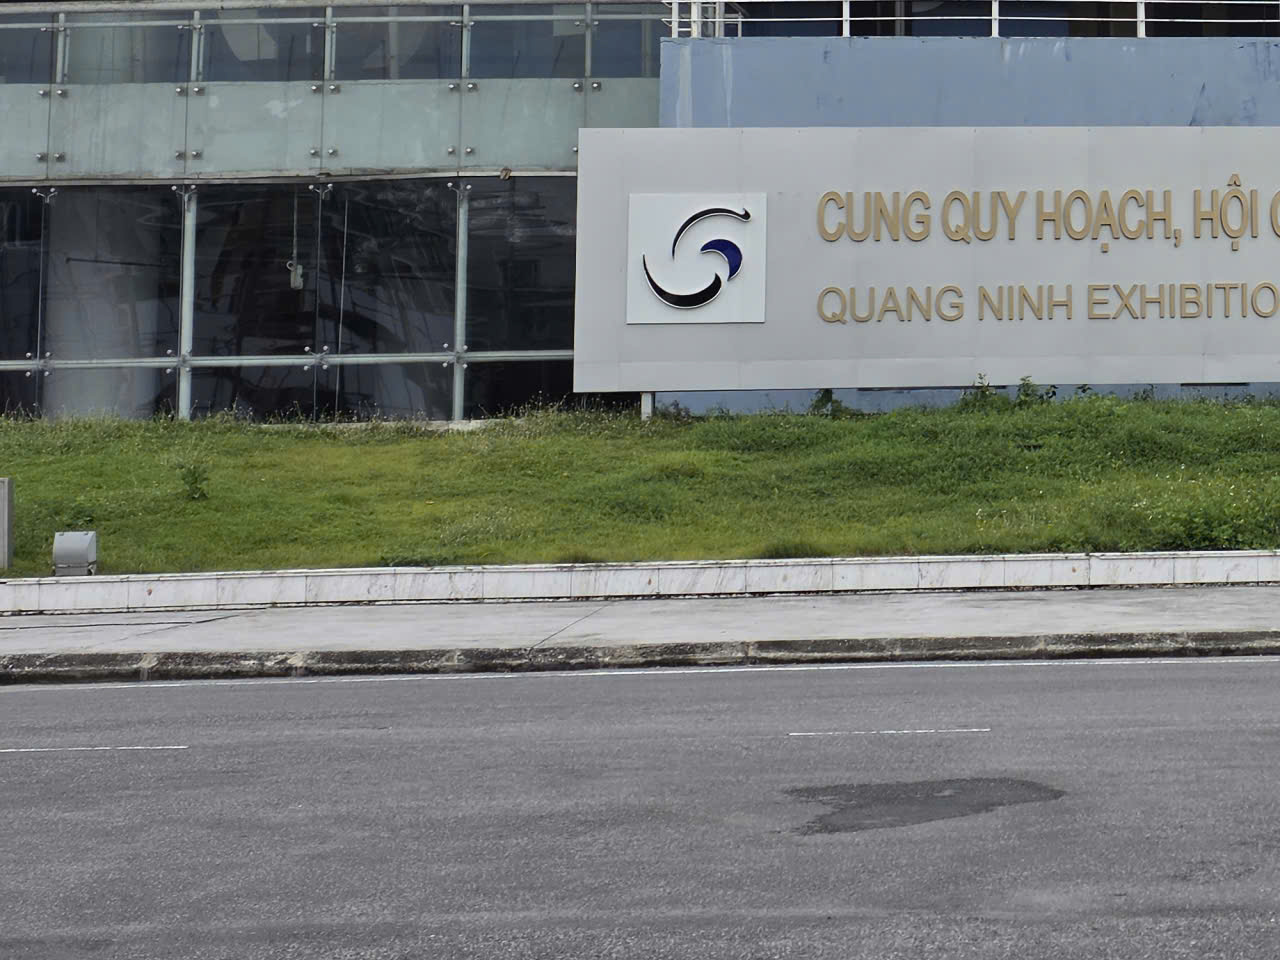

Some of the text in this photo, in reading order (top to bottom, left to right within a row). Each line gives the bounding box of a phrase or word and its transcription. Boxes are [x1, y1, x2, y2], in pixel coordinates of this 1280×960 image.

[817, 190, 931, 242] CUNG
[941, 190, 1026, 244] QUY
[1036, 189, 1182, 253] HOẠCH,
[1193, 173, 1259, 251] HỘI
[817, 286, 964, 324] QUANG
[978, 285, 1073, 321] NINH
